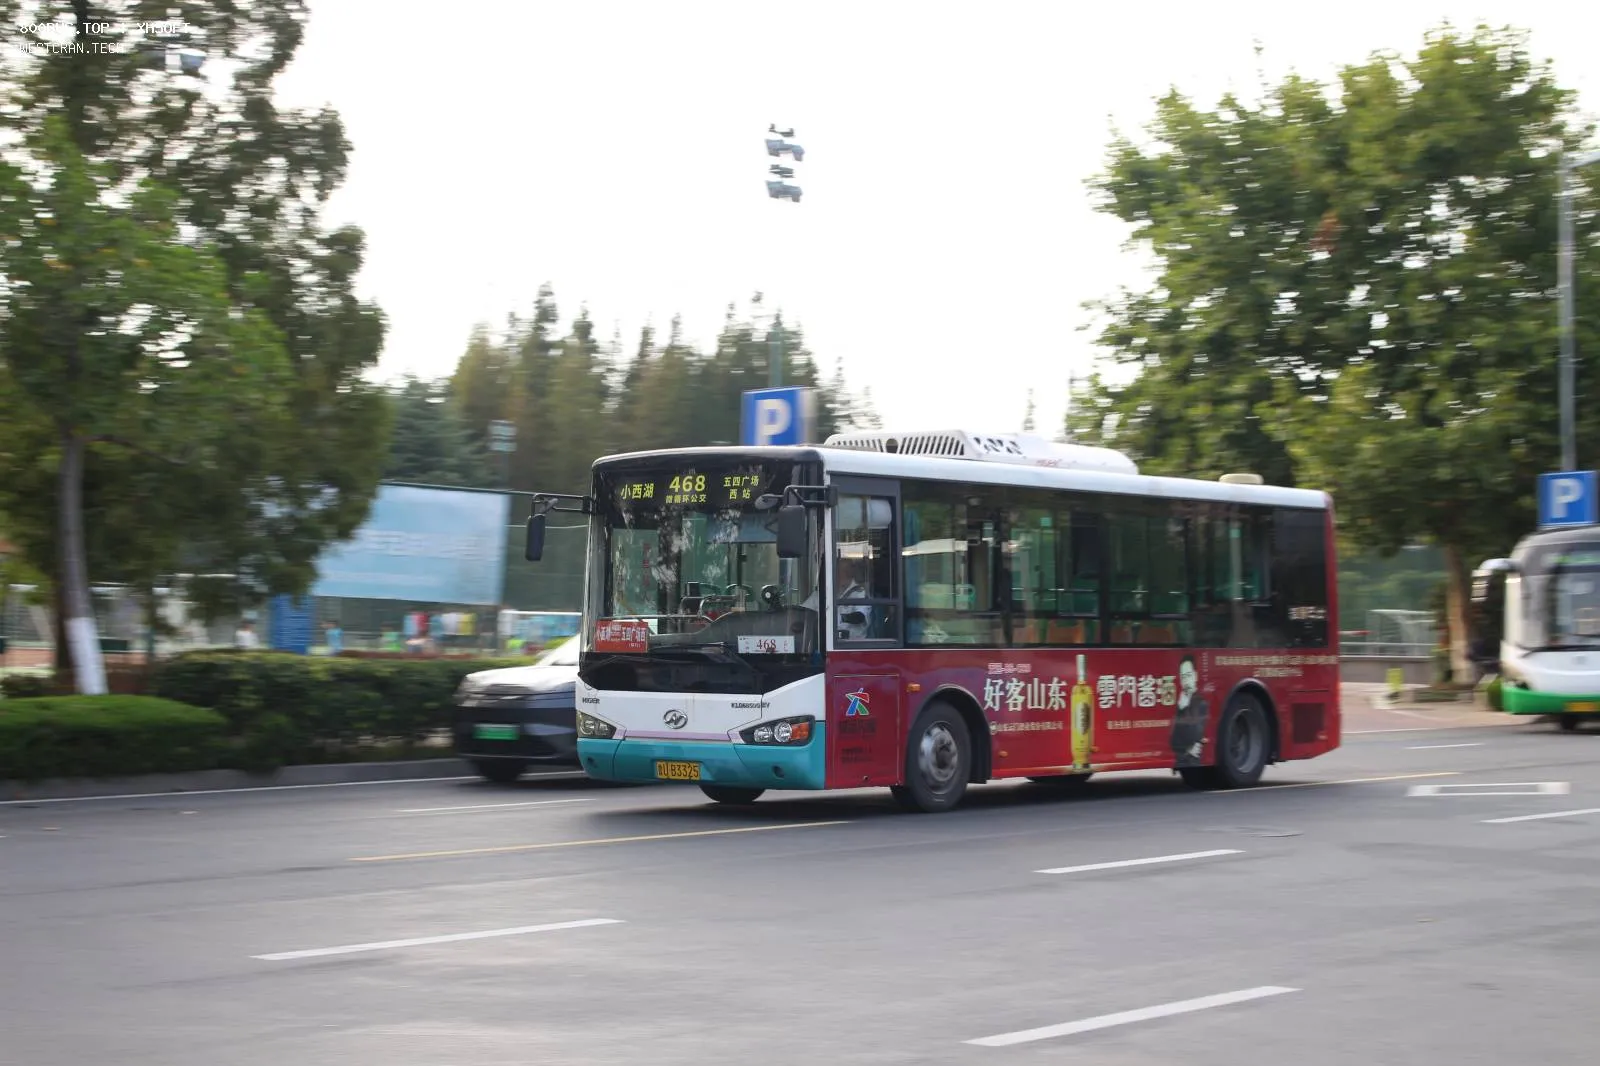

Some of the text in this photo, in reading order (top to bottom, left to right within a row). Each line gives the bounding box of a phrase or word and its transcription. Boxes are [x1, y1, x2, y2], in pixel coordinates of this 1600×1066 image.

[755, 399, 792, 446] P
[669, 475, 706, 492] 468
[723, 475, 760, 487] 五四广场
[620, 483, 655, 500] 小西湖
[1551, 478, 1583, 518] P
[756, 639, 777, 650] 468
[983, 677, 1068, 712] 好客山东
